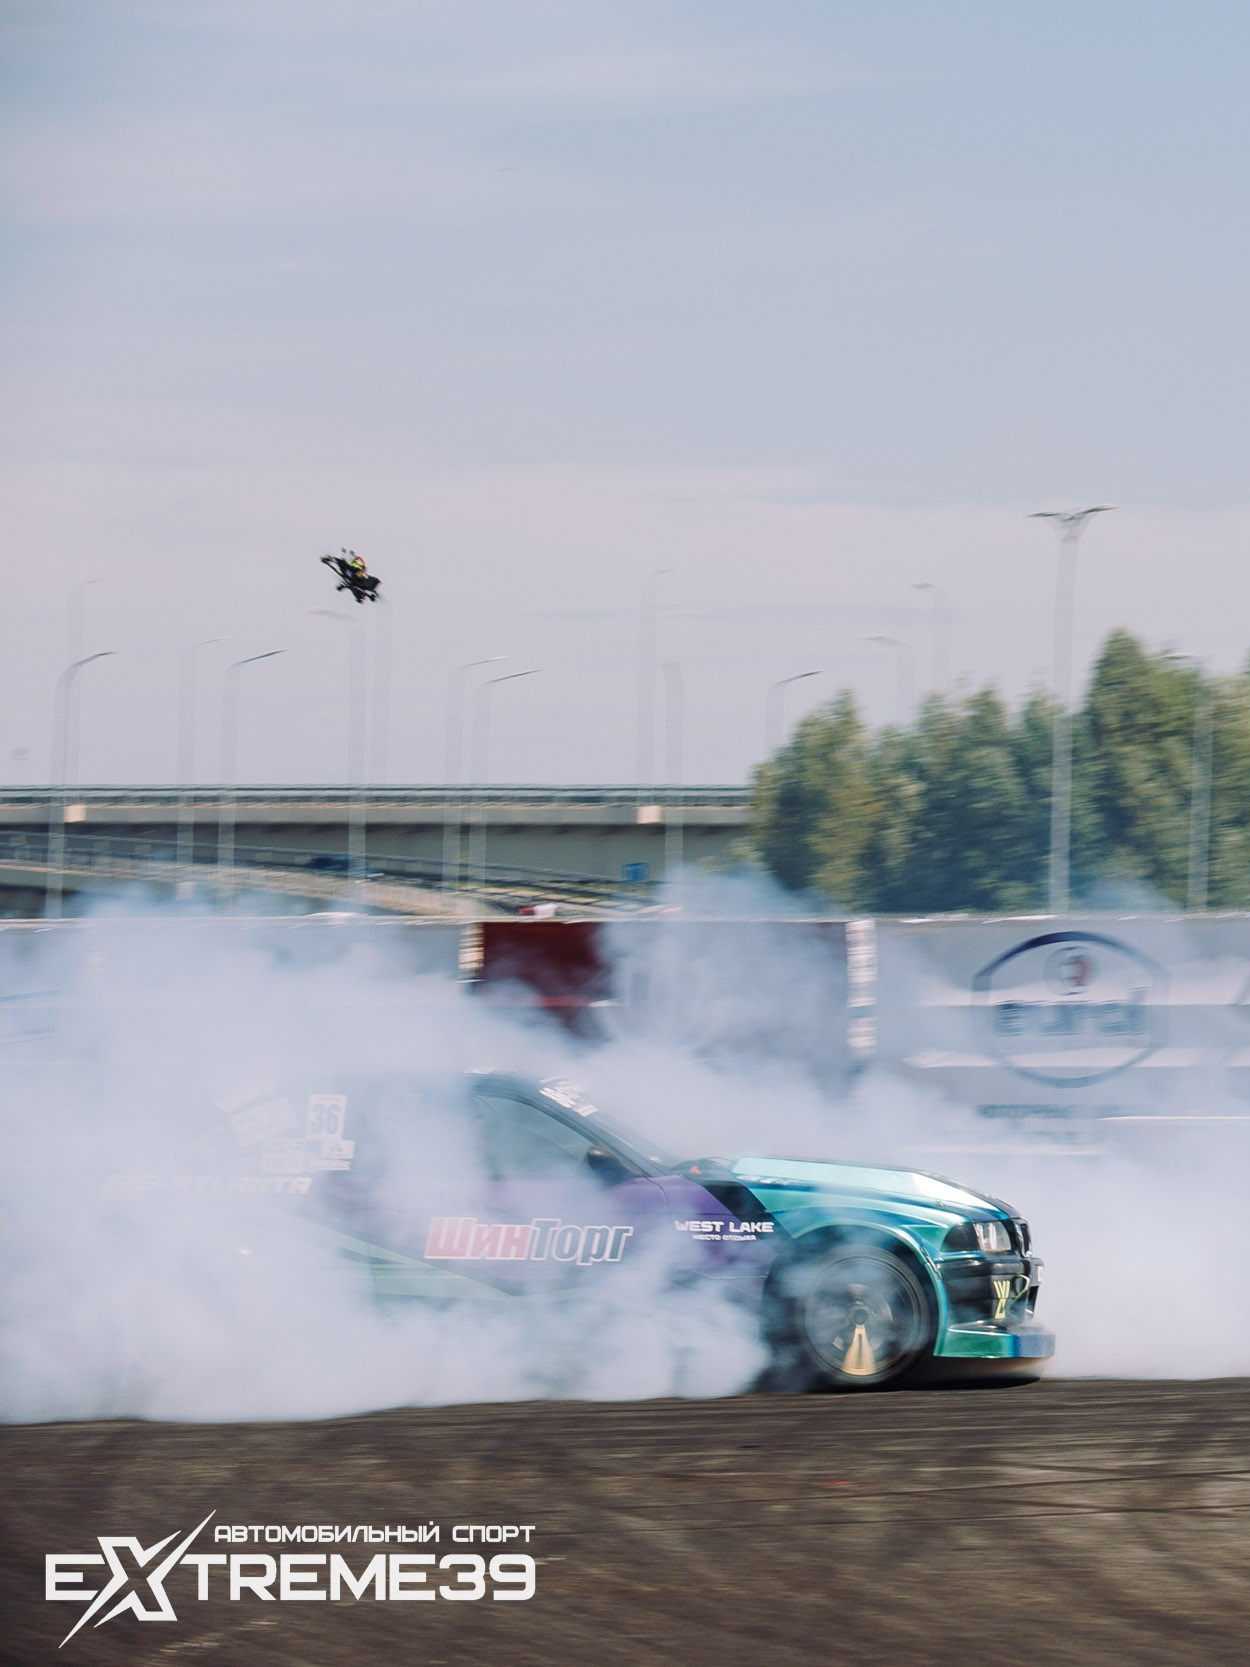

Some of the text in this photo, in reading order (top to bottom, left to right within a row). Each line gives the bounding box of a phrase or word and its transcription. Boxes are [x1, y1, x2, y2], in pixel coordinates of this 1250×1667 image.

[311, 1103, 340, 1134] 36
[424, 1217, 634, 1265] ШинТорг
[675, 1220, 775, 1233] WEST LAKE
